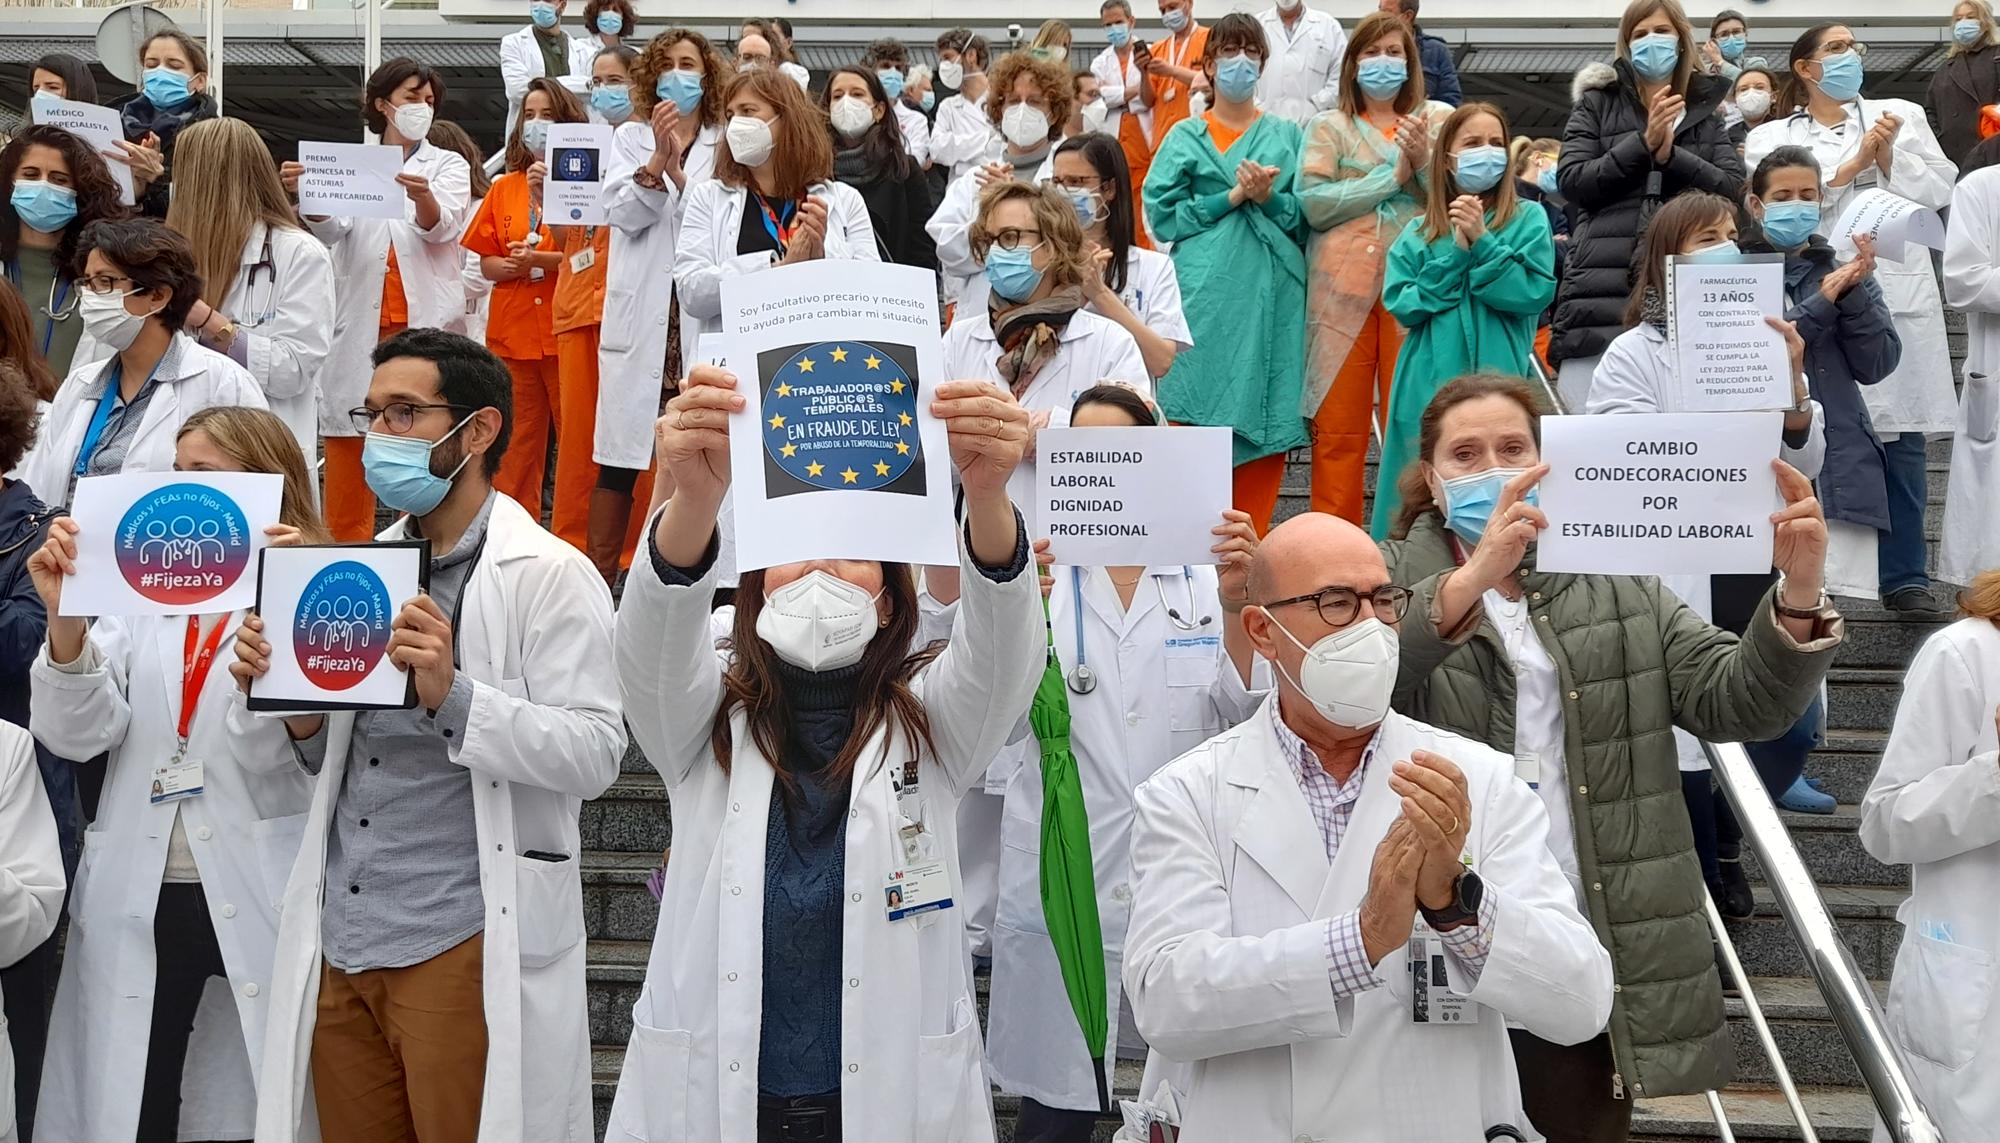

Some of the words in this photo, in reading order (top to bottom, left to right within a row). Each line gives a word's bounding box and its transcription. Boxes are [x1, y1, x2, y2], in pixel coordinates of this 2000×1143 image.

[46, 108, 84, 117] MÉDICO
[48, 121, 109, 131] ESPECIALISTA
[306, 167, 344, 175] PRINCESA
[305, 179, 344, 187] ASTURIAS
[329, 192, 384, 201] PRECARIEDAD
[1703, 293, 1717, 302] 13
[1720, 290, 1755, 303] AÑOS
[739, 307, 758, 318] Soy
[762, 295, 820, 312] facultativo
[823, 293, 869, 307] precario
[872, 296, 879, 304] y
[882, 296, 925, 310] necesito
[739, 324, 750, 334] tu
[753, 316, 785, 331] ayuda
[789, 312, 814, 324] para
[817, 308, 862, 319] cambiar
[866, 310, 879, 318] mi
[882, 311, 928, 326] situación
[1706, 320, 1755, 328] TEMPORALES
[792, 384, 892, 396] TRABAJADOR@S
[1705, 387, 1766, 395] TEMPORALIDAD
[812, 392, 875, 405] PÚBLIC@S
[803, 404, 884, 416] TEMPORALES
[787, 423, 805, 441] EN
[808, 420, 859, 438] FRAUDE
[862, 420, 880, 436] DE
[881, 422, 900, 438] LEY
[813, 441, 833, 449] ABUSO
[850, 440, 894, 449] TEMPORALIDAD
[1626, 442, 1698, 455] CAMBIO
[1050, 452, 1143, 463] ESTABILIDAD
[1574, 467, 1747, 482] CONDECORACIONES
[1050, 476, 1116, 487] LABORAL
[1050, 500, 1123, 512] DIGNIDAD
[1642, 496, 1678, 510] POR
[124, 509, 149, 549] Médicos
[147, 504, 154, 514] y
[154, 493, 181, 507] FEAs
[183, 493, 198, 501] no
[199, 493, 221, 511] fijos
[222, 512, 242, 546] Madrid
[1050, 524, 1149, 536] PROFESIONAL
[1562, 523, 1673, 538] ESTABILIDAD
[1678, 525, 1754, 538] LABORAL
[140, 572, 223, 590] #FijezaYa
[300, 588, 320, 629] Médicos
[324, 572, 344, 587] FEAs
[345, 572, 356, 580] no
[356, 572, 372, 591] fijos
[371, 593, 384, 630] Madrid
[307, 655, 366, 673] #FijezaYa
